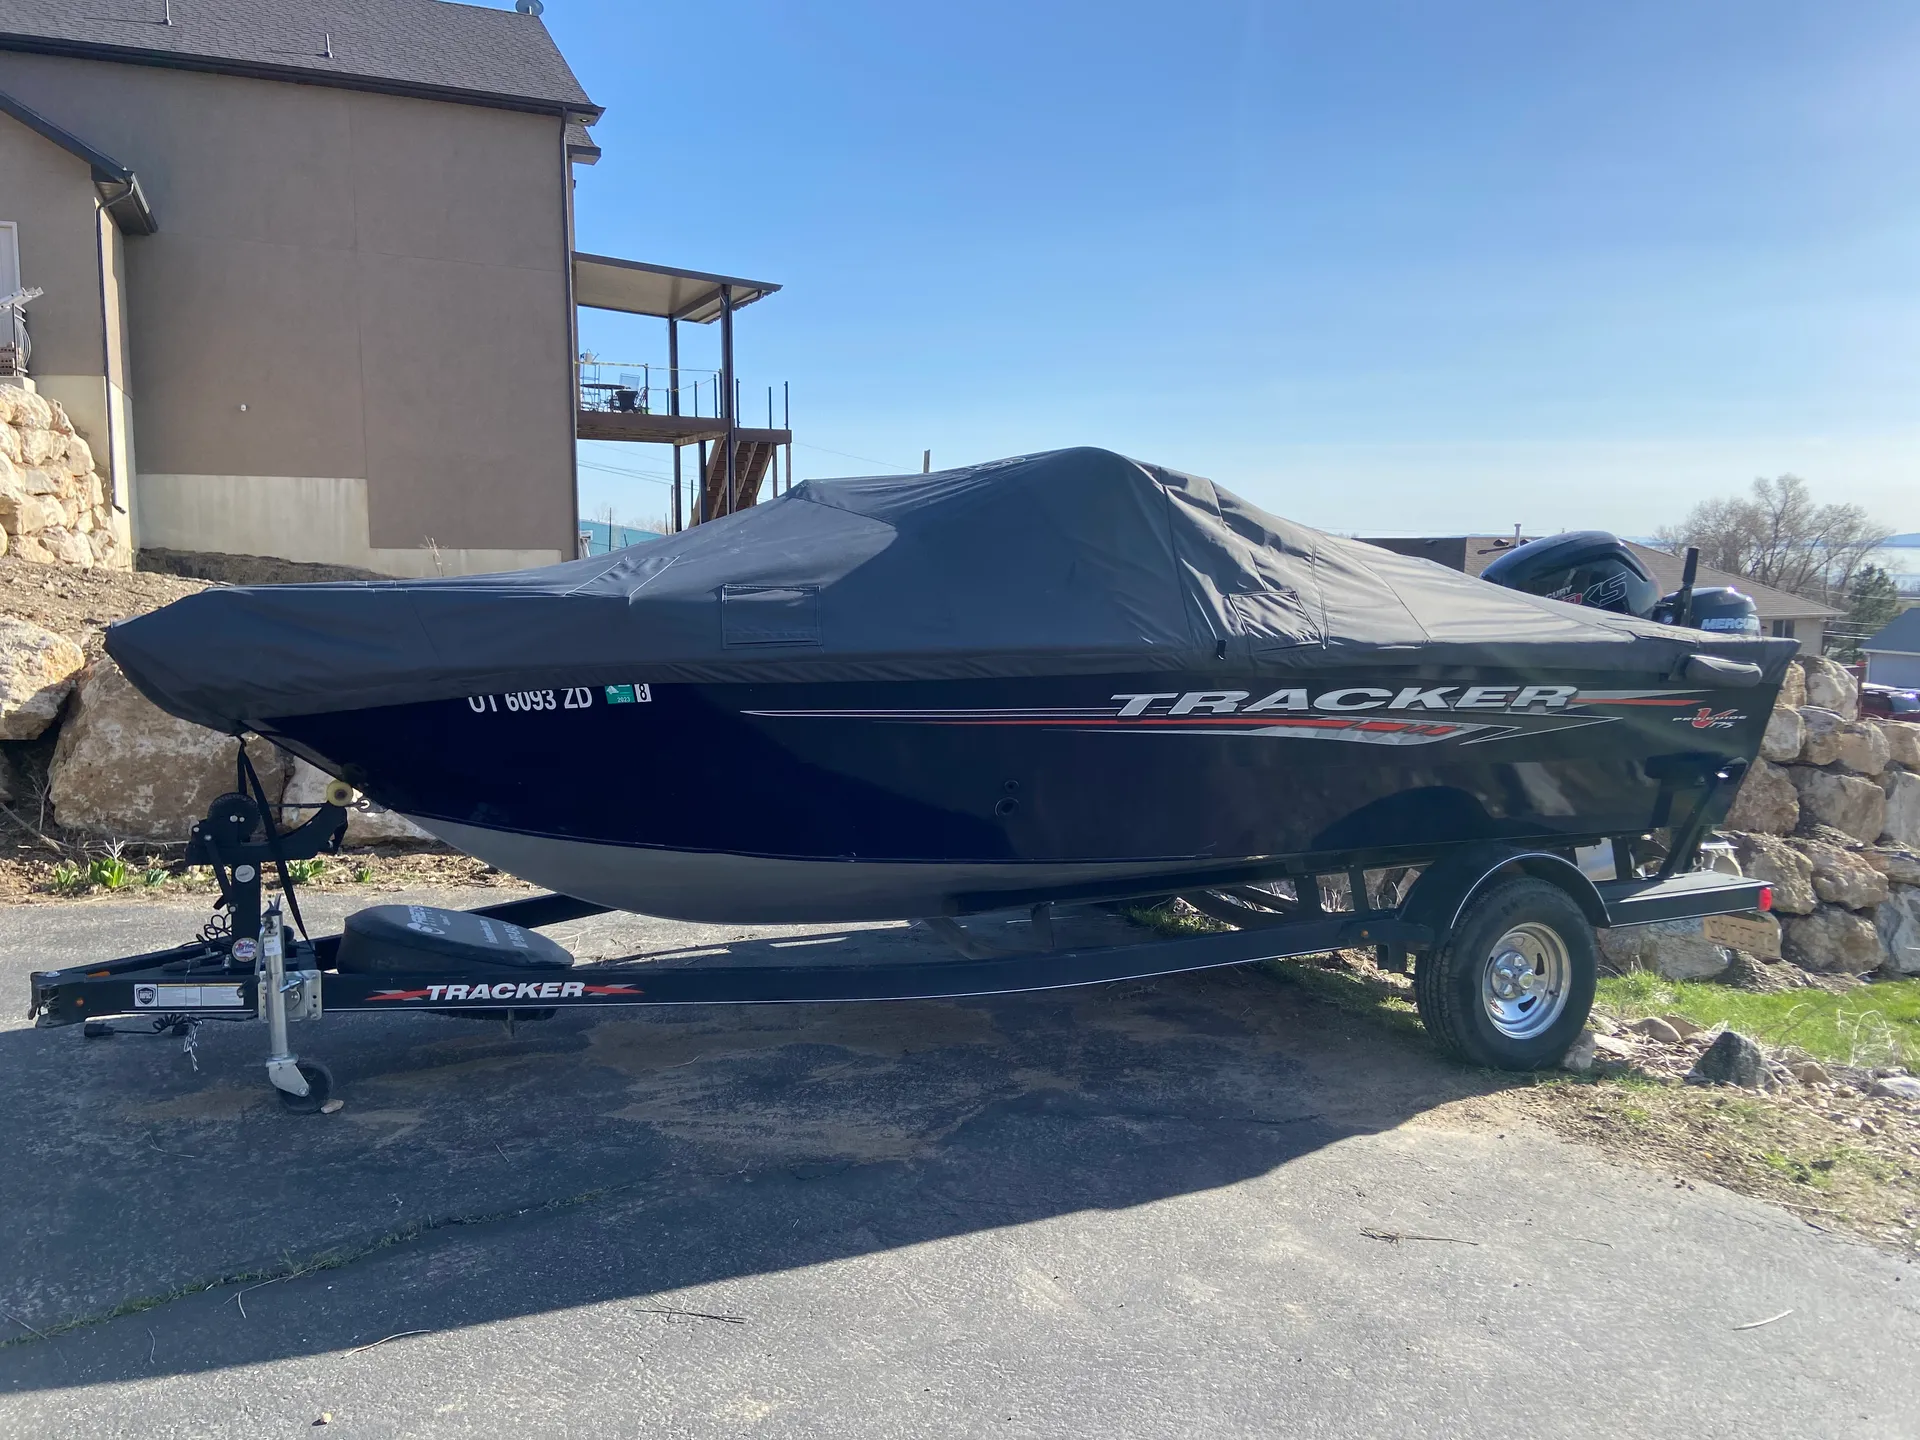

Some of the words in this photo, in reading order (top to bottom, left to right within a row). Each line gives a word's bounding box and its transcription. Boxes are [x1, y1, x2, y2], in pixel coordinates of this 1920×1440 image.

[505, 690, 557, 711] 6093
[561, 686, 593, 709] ZD
[1110, 685, 1580, 716] TRACKER
[426, 981, 586, 1001] TRACKER
